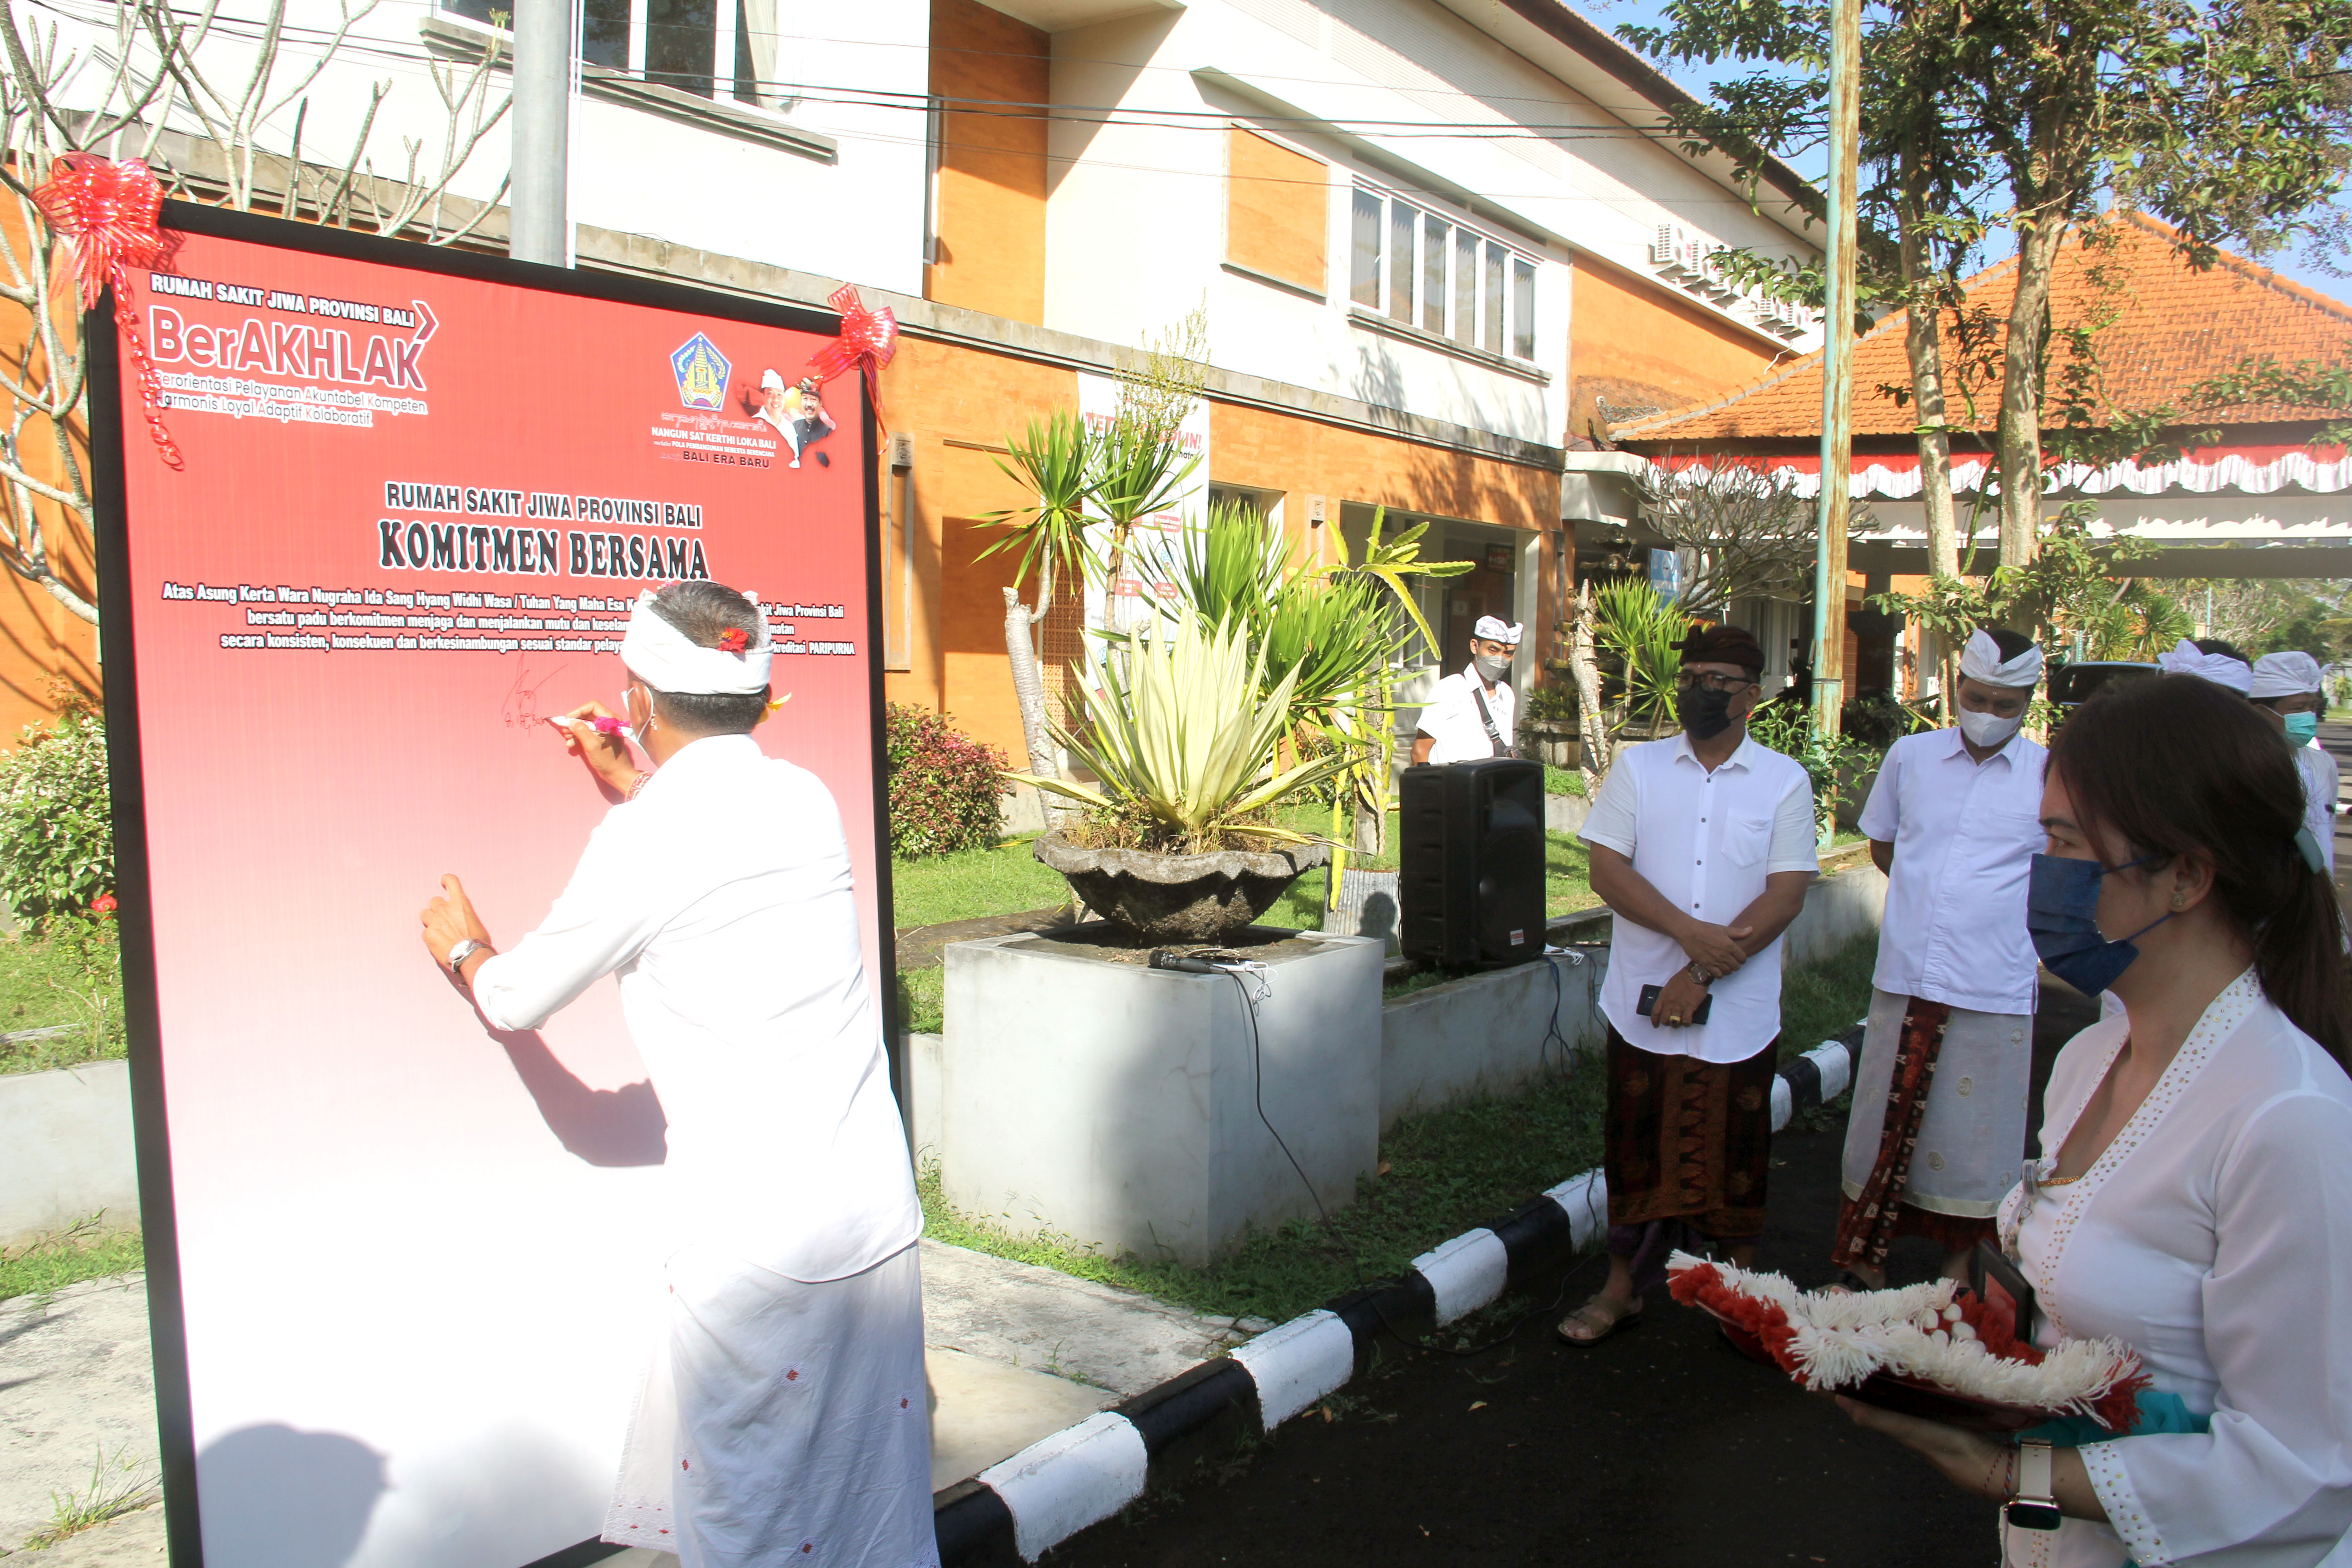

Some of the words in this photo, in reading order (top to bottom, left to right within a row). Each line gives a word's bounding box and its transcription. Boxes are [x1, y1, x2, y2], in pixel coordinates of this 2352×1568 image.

[150, 273, 212, 299] RUMAH
[216, 283, 264, 307] SAKIT
[267, 291, 306, 313] JIWA
[309, 297, 379, 323] PROVINSI
[383, 307, 415, 328] BALI
[150, 304, 427, 392] BerAKHLAK
[155, 391, 218, 410] Harmonis
[222, 399, 254, 416] Loyal
[258, 403, 303, 420] Adaptif
[306, 408, 370, 425] Kolaboratif
[235, 381, 301, 399] Pelayanan
[305, 389, 364, 406] Akuntabel
[368, 396, 425, 412] Kompeten
[652, 427, 688, 440] NANGUN
[690, 432, 705, 441] SAT
[706, 433, 735, 445] KERTHI
[736, 436, 758, 447] LOKA
[759, 439, 776, 449] BALI
[686, 442, 724, 452] PEMBANGUNAN
[724, 446, 746, 455] SEMESTA
[746, 448, 775, 457] BERENCANA
[684, 451, 710, 462] BALI
[714, 454, 736, 465] ERA
[740, 456, 770, 468] BARU
[387, 483, 460, 510] RUMAH
[467, 490, 522, 514] SAKIT
[528, 494, 573, 518] JIWA
[578, 498, 659, 524] PROVINSI
[666, 505, 701, 527] BALI
[380, 521, 558, 574] KOMITMEN
[570, 533, 708, 579] BERSAMA
[162, 583, 194, 600] Atas
[196, 584, 237, 605] Asung
[239, 585, 276, 602] Kerta
[277, 586, 310, 603] Wara
[312, 588, 363, 607] Nugraha
[364, 589, 383, 605] Ida
[385, 590, 414, 610] Sang
[416, 591, 451, 610] Hyang
[451, 592, 483, 608] Widhi
[483, 593, 513, 609] Wasa
[514, 594, 519, 609] /
[519, 594, 551, 610] Tuhan
[552, 595, 578, 613] Yang
[579, 596, 606, 611] Maha
[607, 597, 625, 612] Esa
[757, 602, 773, 616] kit
[774, 603, 794, 617] Jiwa
[795, 604, 827, 617] Provinsi
[828, 605, 844, 618] Bali
[247, 609, 295, 625] bersatu
[297, 610, 328, 629] padu
[330, 611, 405, 627] berkomitmen
[407, 613, 454, 632] menjaga
[456, 613, 476, 628] dan
[478, 615, 544, 632] menjalankan
[545, 617, 570, 631] mutu
[572, 617, 591, 631] dan
[220, 635, 265, 648] secara
[266, 632, 330, 652] konsisten,
[332, 632, 394, 649] konsekuen
[396, 634, 417, 649] dan
[419, 634, 519, 654] berkesinambungan
[521, 635, 554, 651] sesuai
[555, 637, 593, 651] standar
[771, 640, 806, 654] kreditasi
[808, 642, 855, 656] PARIPURNA
